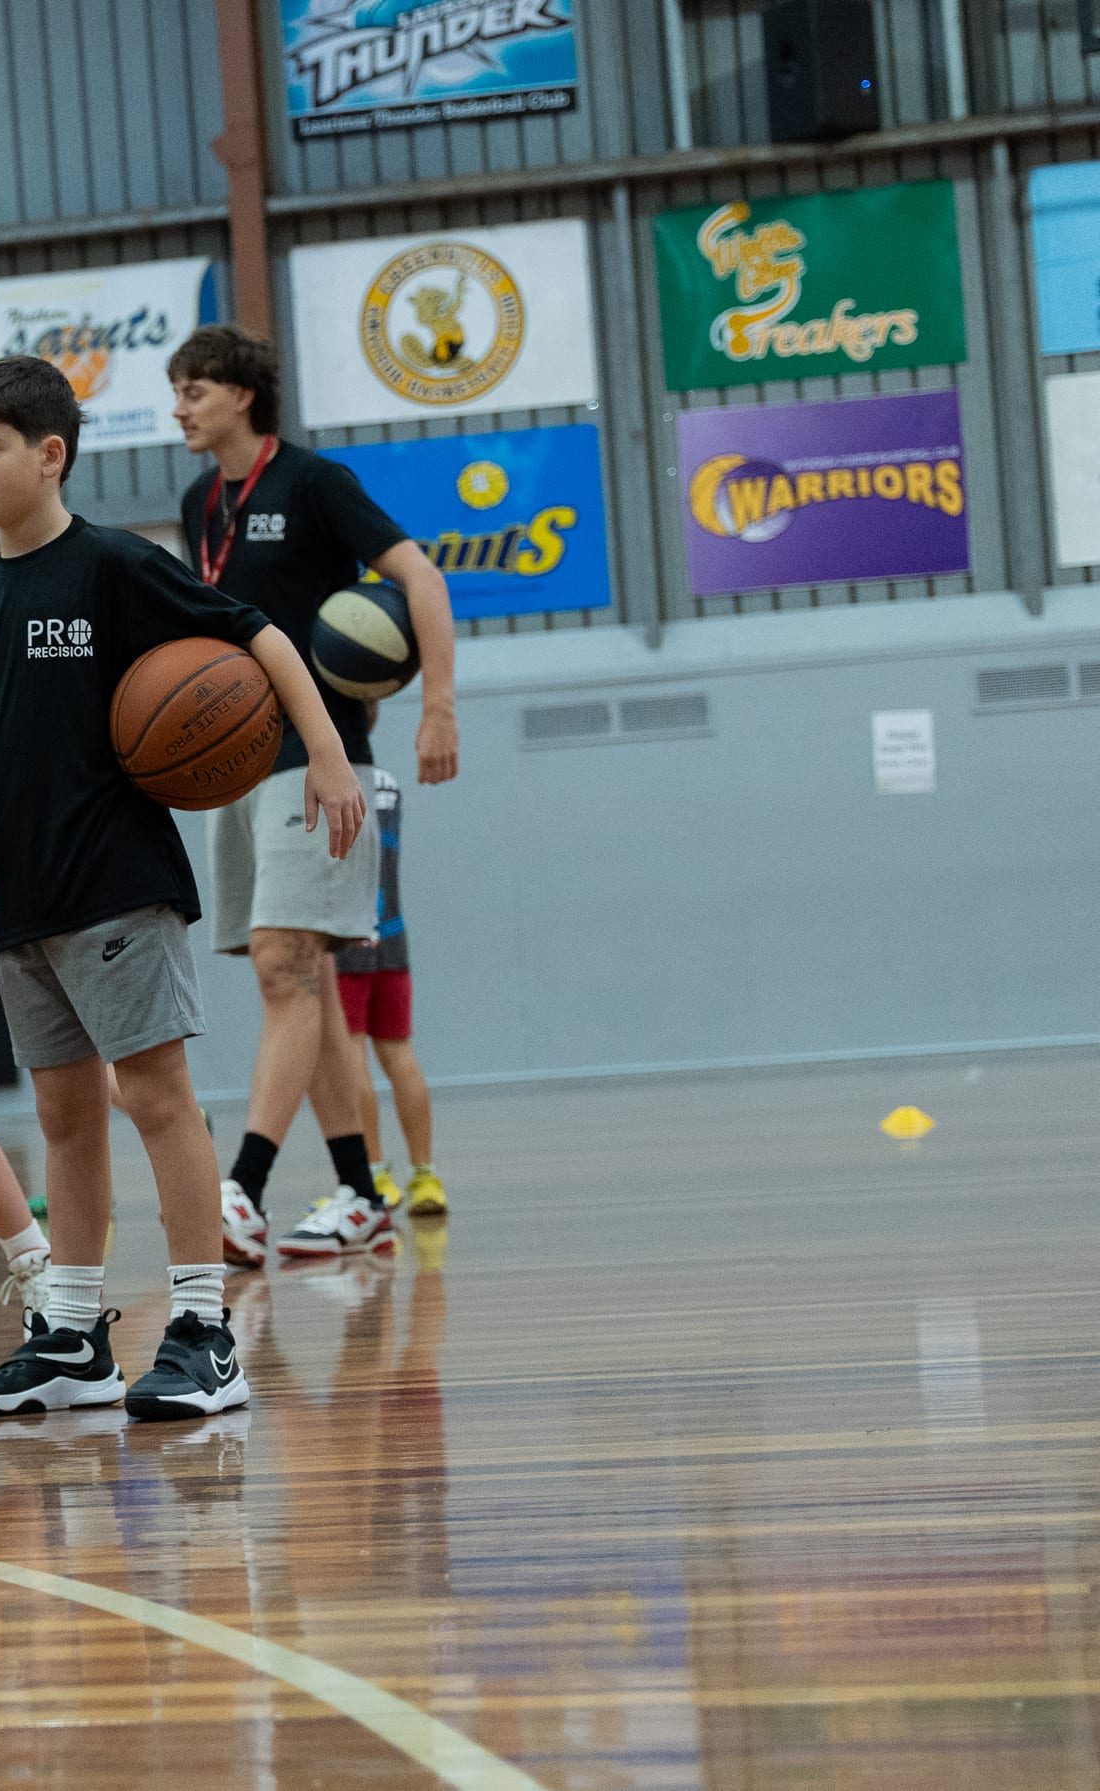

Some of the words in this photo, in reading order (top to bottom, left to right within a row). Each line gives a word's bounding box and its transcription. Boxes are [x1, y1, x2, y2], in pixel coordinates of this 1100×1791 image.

[290, 0, 572, 107] THUNDER
[528, 90, 571, 111] Club
[728, 458, 964, 534] WARRIORS
[27, 646, 94, 659] PRECISION
[194, 700, 230, 733] ELITE
[166, 729, 195, 756] PRO
[192, 705, 280, 787] SPALDING
